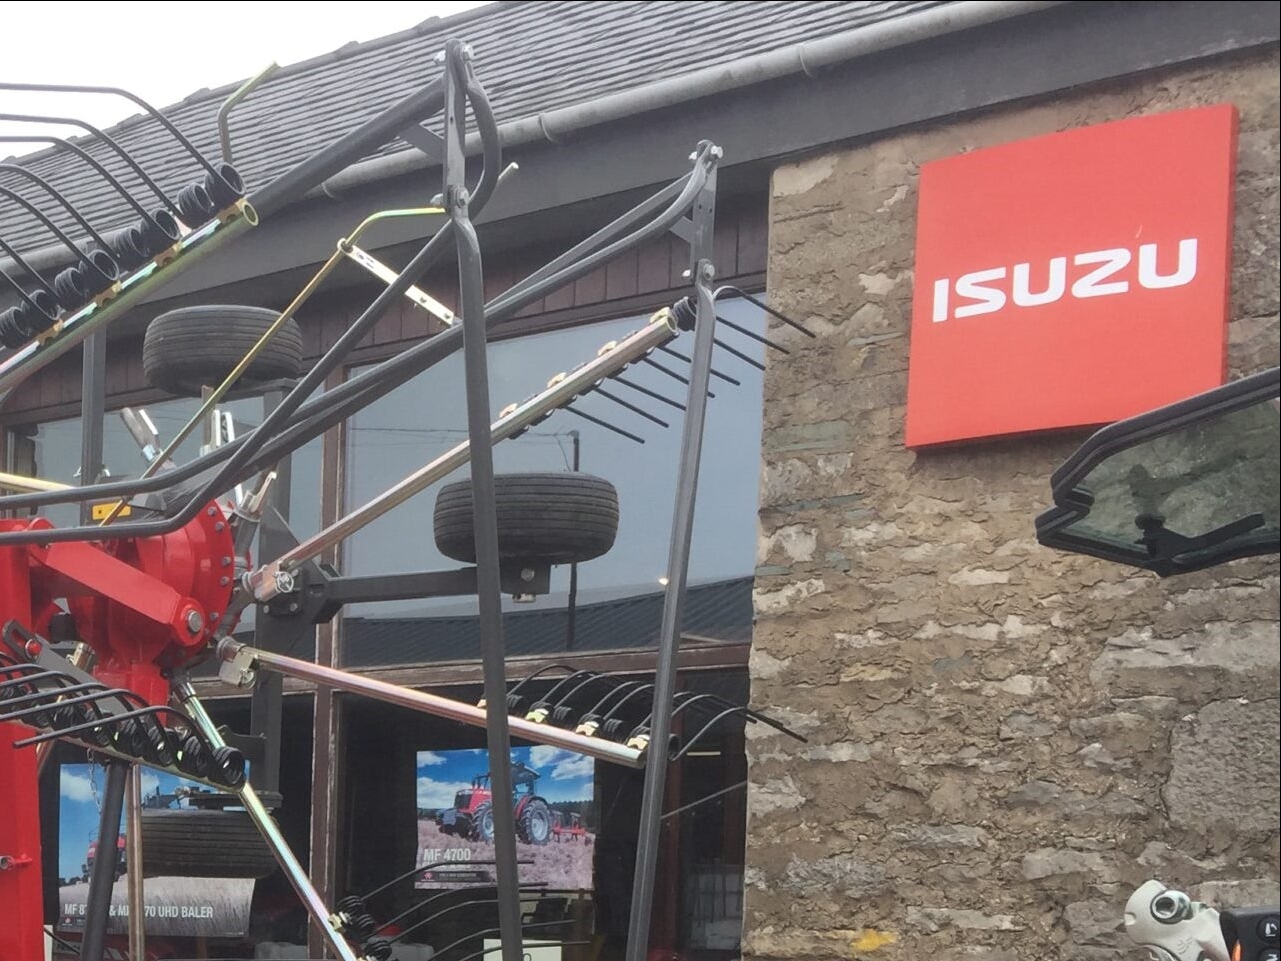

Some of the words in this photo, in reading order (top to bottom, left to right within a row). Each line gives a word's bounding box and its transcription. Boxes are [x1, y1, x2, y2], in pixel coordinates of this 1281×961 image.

[932, 238, 1198, 323] ISUZU
[423, 849, 441, 861] MF
[443, 848, 472, 861] 4700
[64, 903, 78, 915] MF
[158, 906, 179, 918] UHD
[181, 906, 214, 919] BALER
